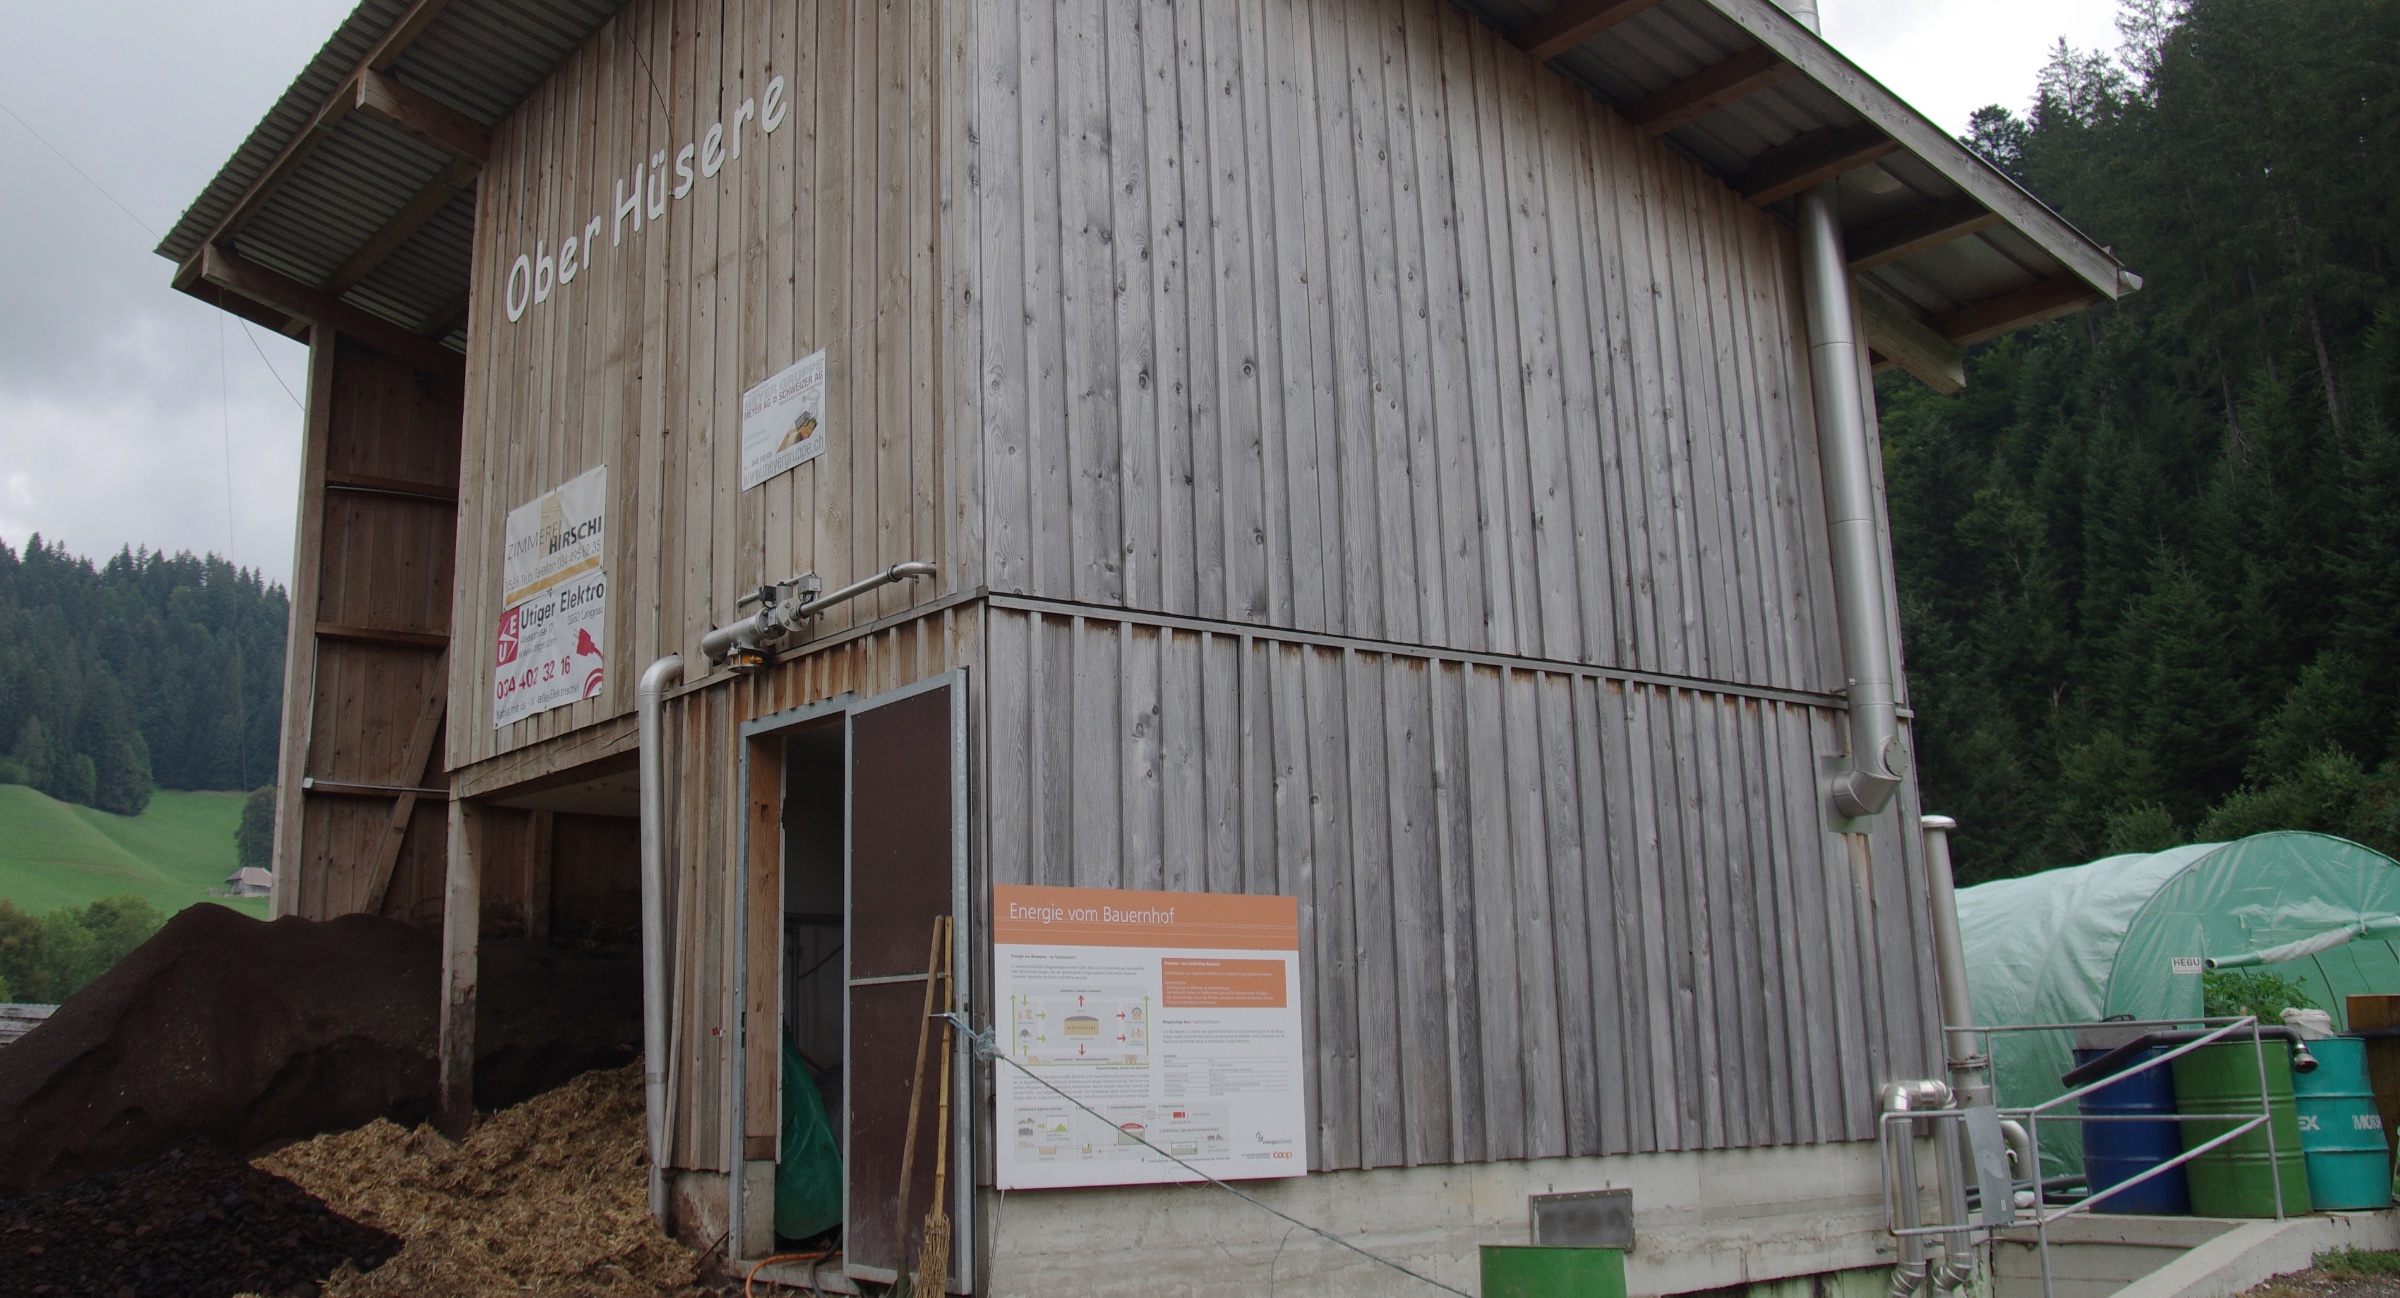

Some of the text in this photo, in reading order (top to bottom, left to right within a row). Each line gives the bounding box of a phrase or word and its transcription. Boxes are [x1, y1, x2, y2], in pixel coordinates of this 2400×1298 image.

[506, 75, 787, 322] Ober Hüsere
[743, 383, 777, 411] MEYER
[779, 356, 824, 390] GRUPPE
[744, 403, 762, 421] MEYER
[763, 398, 771, 410] AG
[778, 375, 813, 401] SCHWEIZER
[814, 369, 824, 383] AG
[741, 433, 824, 488] www.meyergruppe.ch
[507, 519, 562, 561] ZIMMEREI
[549, 515, 602, 555] HIRSCHI
[535, 561, 557, 578] Telefon
[521, 583, 604, 630] Utiger Elektro
[496, 655, 571, 700] 034 402 32 16
[1010, 902, 1175, 925] Energie vom Bauernhof
[2173, 958, 2200, 967] HEBU
[1272, 1151, 1293, 1160] coop
